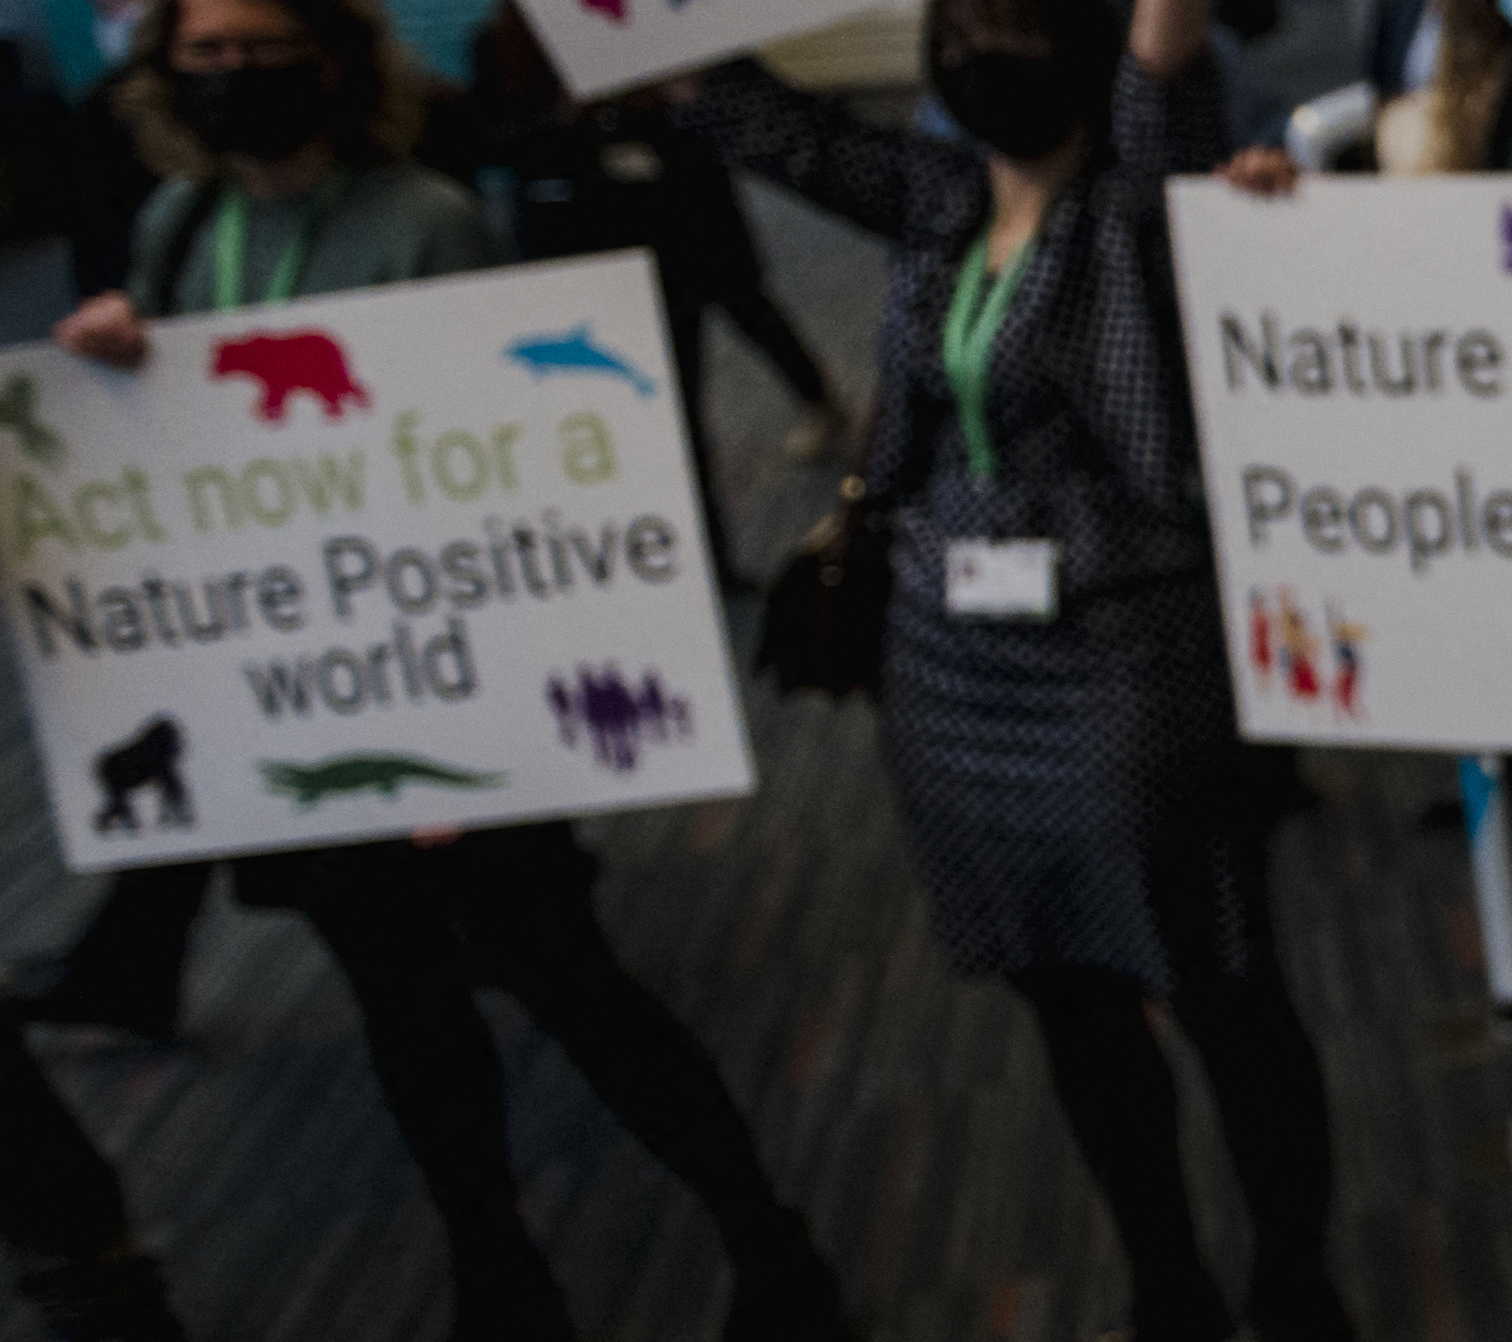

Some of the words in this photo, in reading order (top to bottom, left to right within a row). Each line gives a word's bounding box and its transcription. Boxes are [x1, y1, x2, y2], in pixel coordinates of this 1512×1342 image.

[1220, 308, 1505, 398] Nature
[9, 462, 168, 550] Act
[184, 443, 368, 529] now
[392, 409, 524, 506] for
[555, 408, 619, 485] a
[22, 564, 306, 656] Nature
[322, 509, 678, 618] Positive
[244, 615, 478, 718] world
